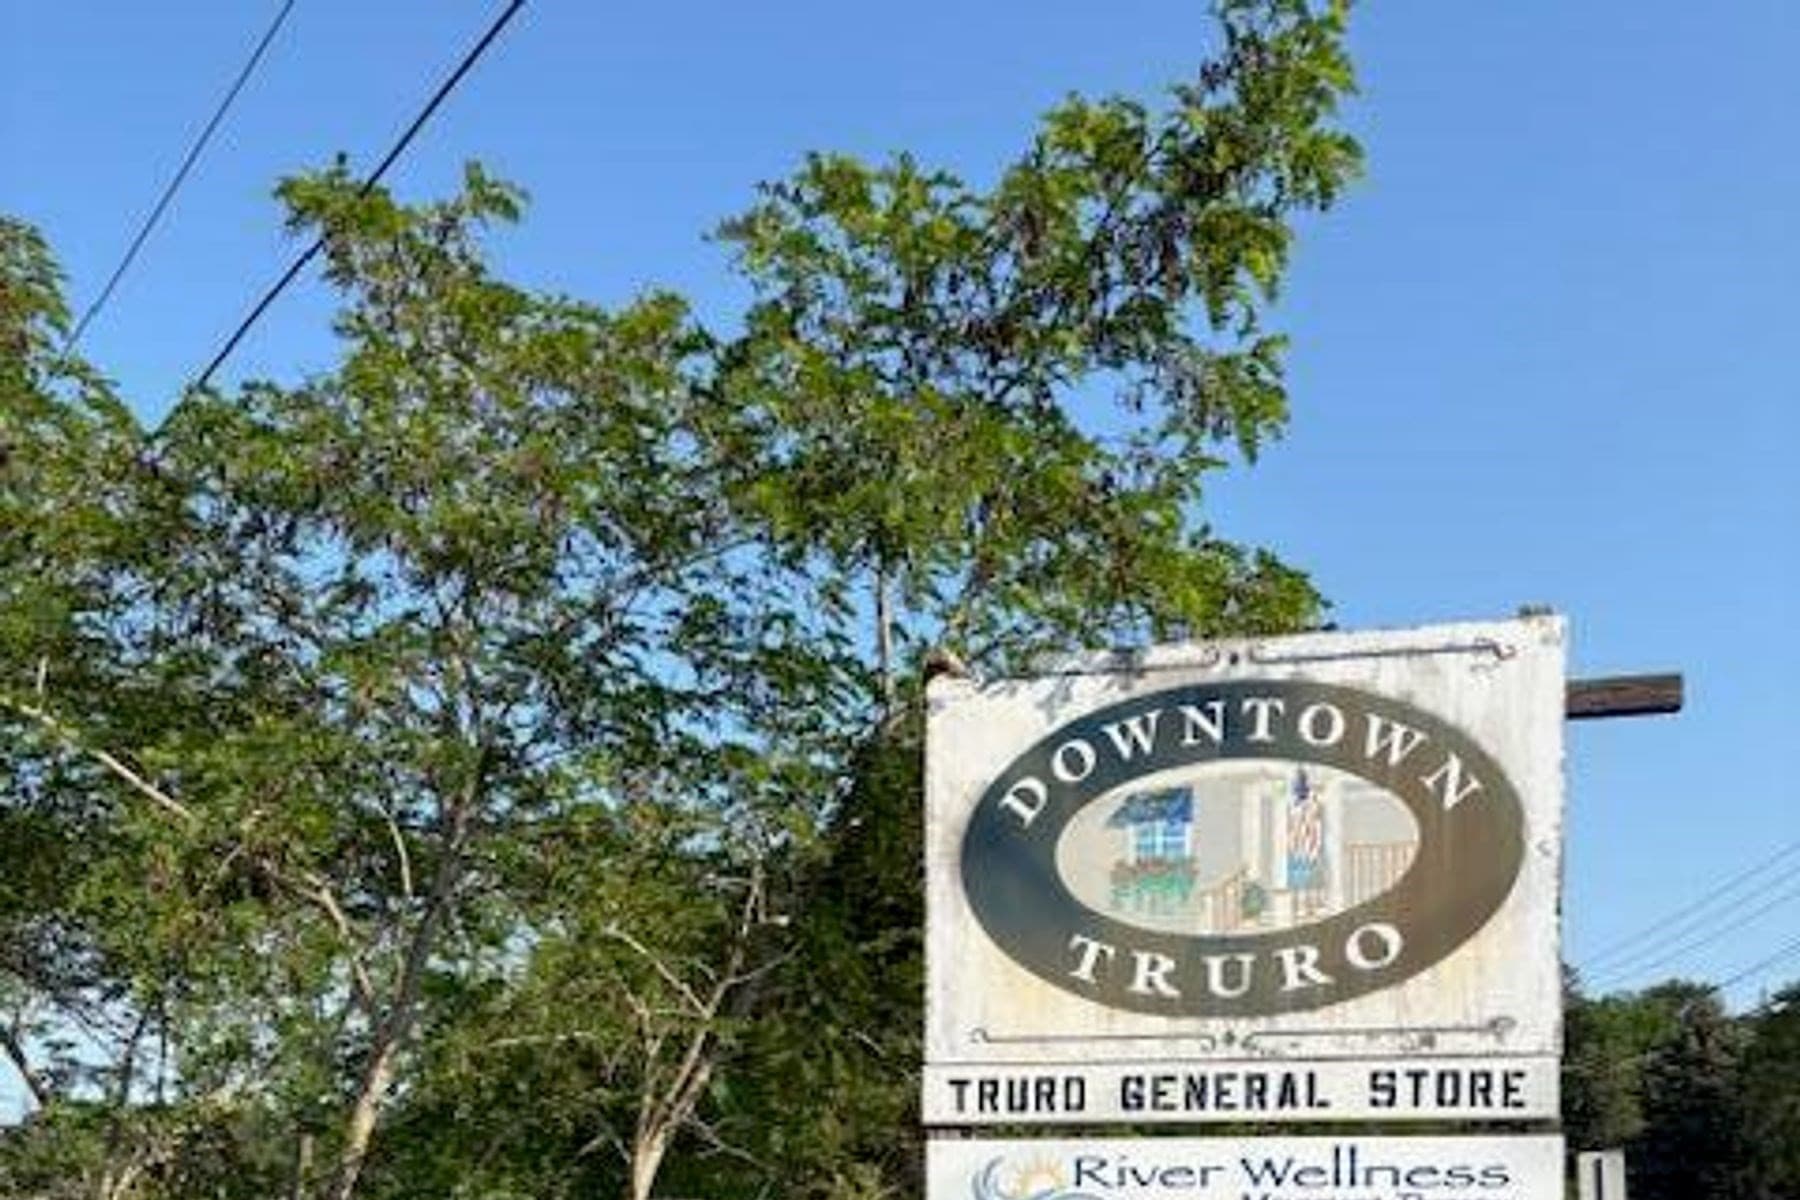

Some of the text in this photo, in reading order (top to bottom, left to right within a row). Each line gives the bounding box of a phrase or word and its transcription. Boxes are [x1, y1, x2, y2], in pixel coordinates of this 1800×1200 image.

[1001, 698, 1481, 828] DOWNTOWN
[1068, 922, 1402, 1000] TRURO
[948, 1070, 1527, 1112] TRURO GENERAL STORE
[1075, 1145, 1511, 1188] River Wellness
